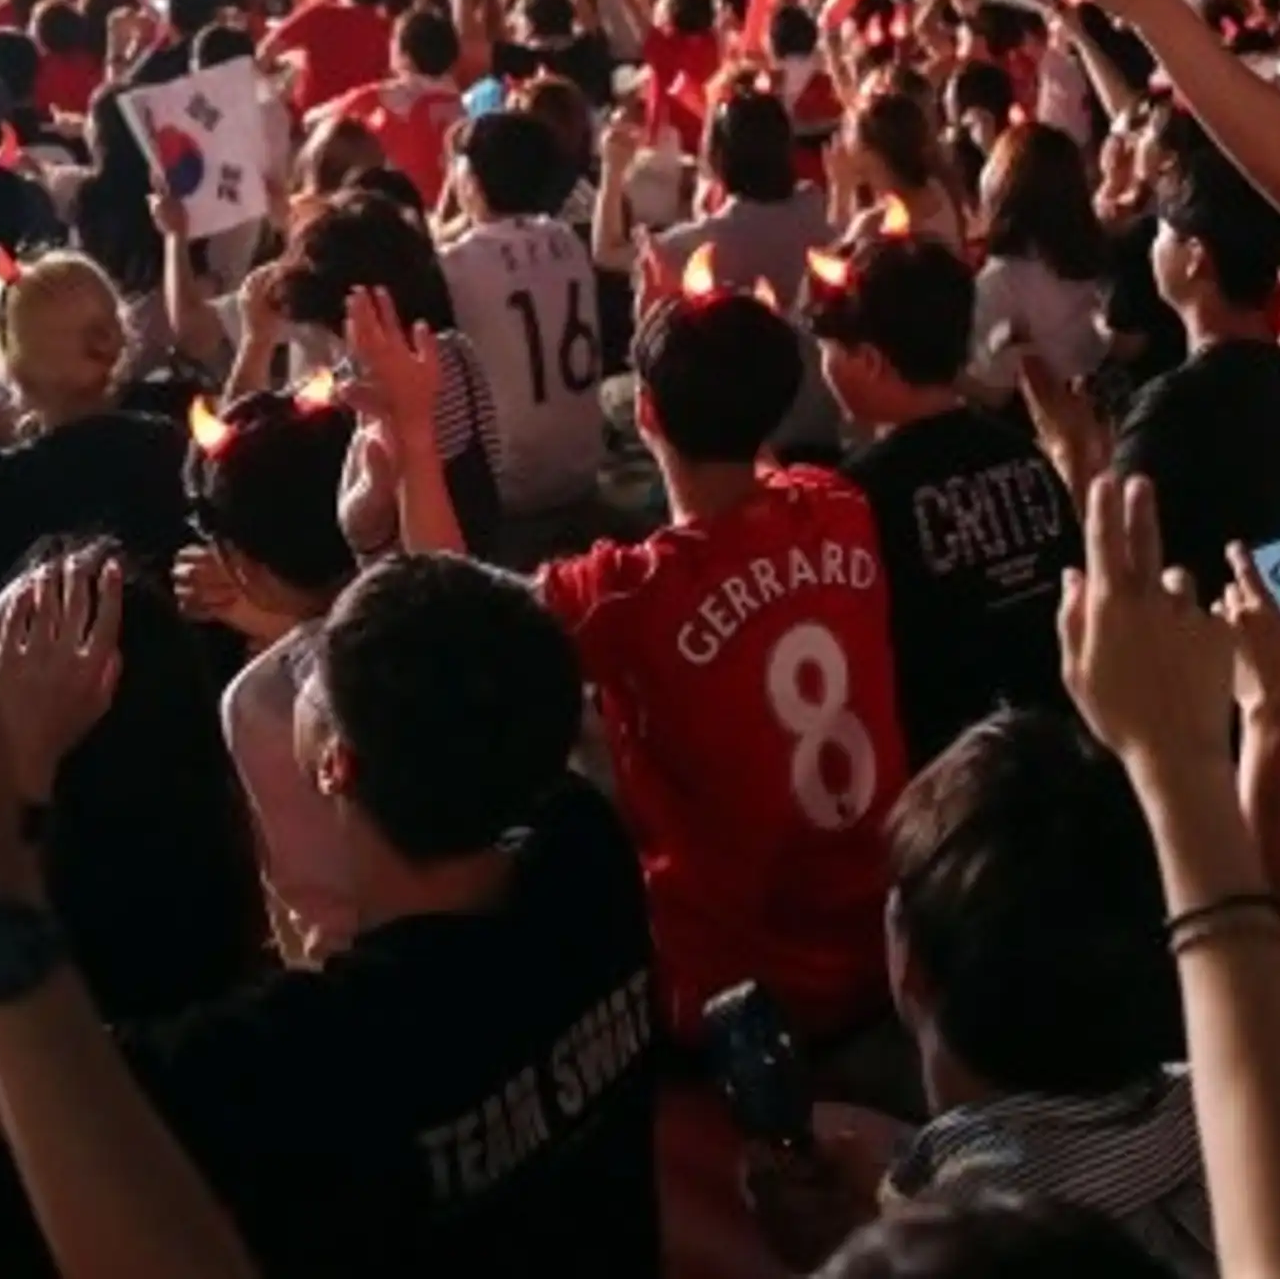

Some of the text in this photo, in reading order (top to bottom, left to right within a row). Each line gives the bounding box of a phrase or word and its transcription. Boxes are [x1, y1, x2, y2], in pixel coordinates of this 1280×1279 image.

[509, 280, 596, 403] 16
[678, 539, 877, 665] GERRARD
[766, 624, 877, 830] 8
[415, 968, 652, 1199] TEAM SWAT
